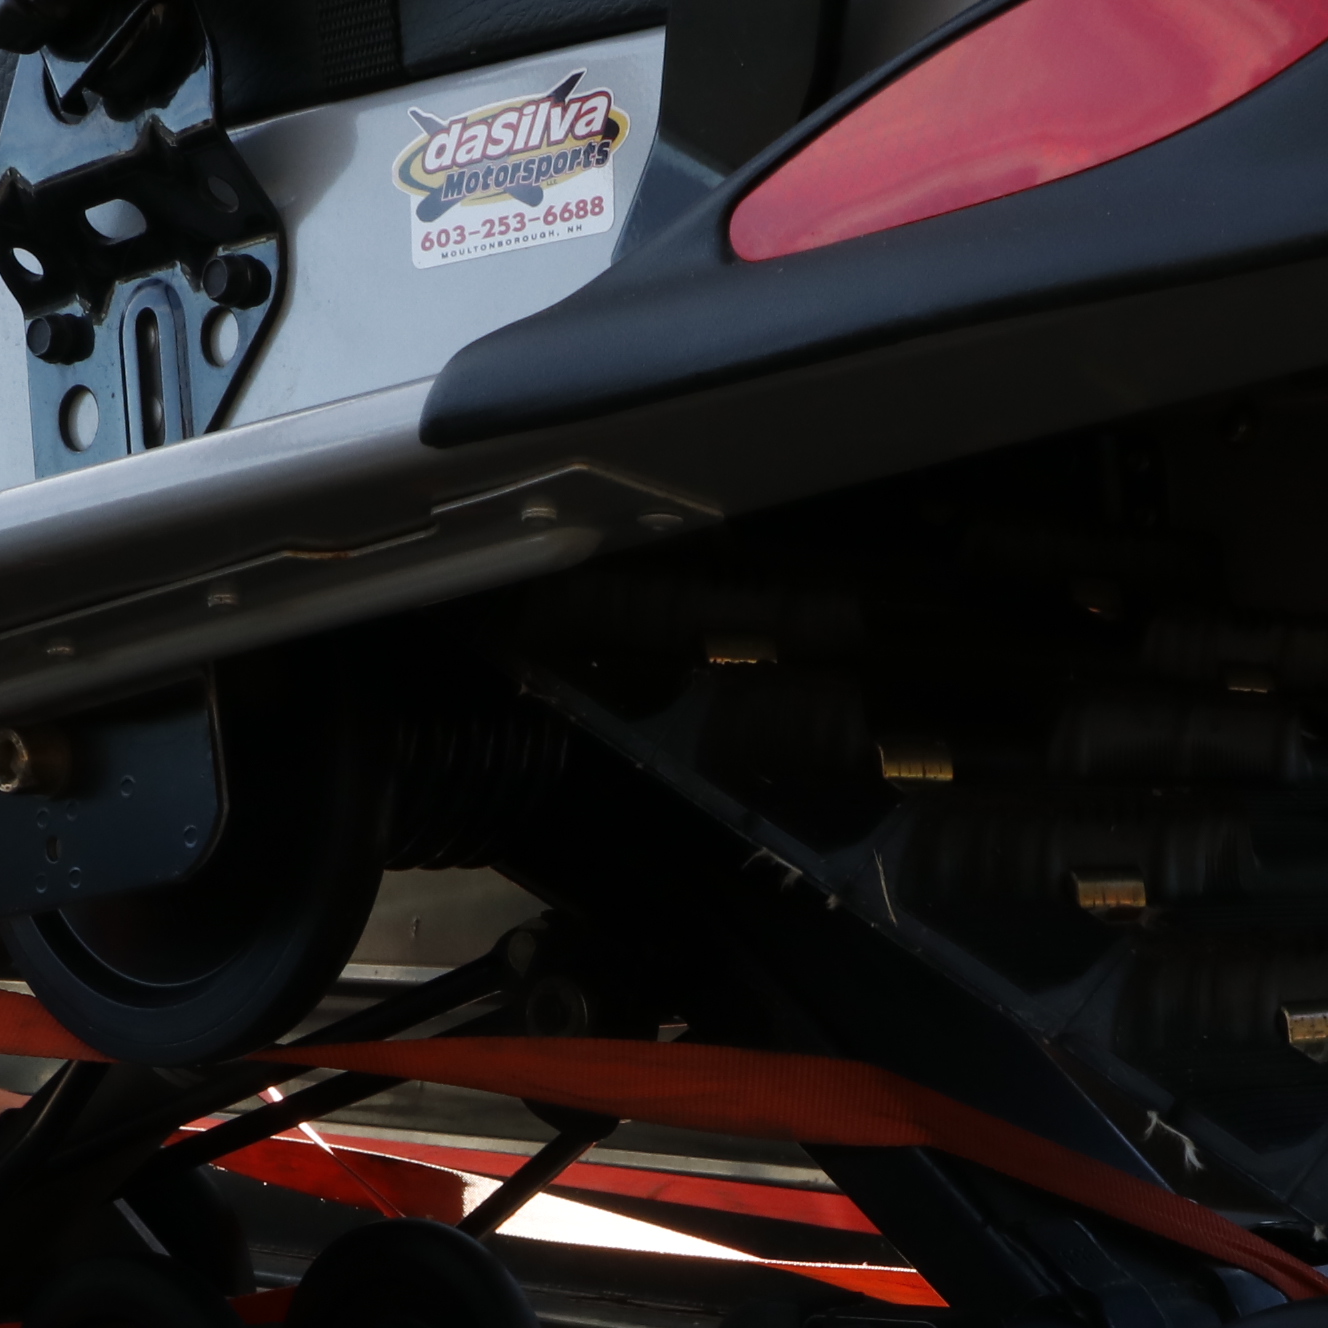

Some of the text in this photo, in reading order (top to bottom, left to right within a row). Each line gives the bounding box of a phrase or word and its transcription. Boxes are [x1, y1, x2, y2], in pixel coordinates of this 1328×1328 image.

[442, 139, 610, 200] Motorsports
[421, 196, 604, 251] 603-253-6688
[441, 224, 583, 259] MOULTONBOROUGH, NH
